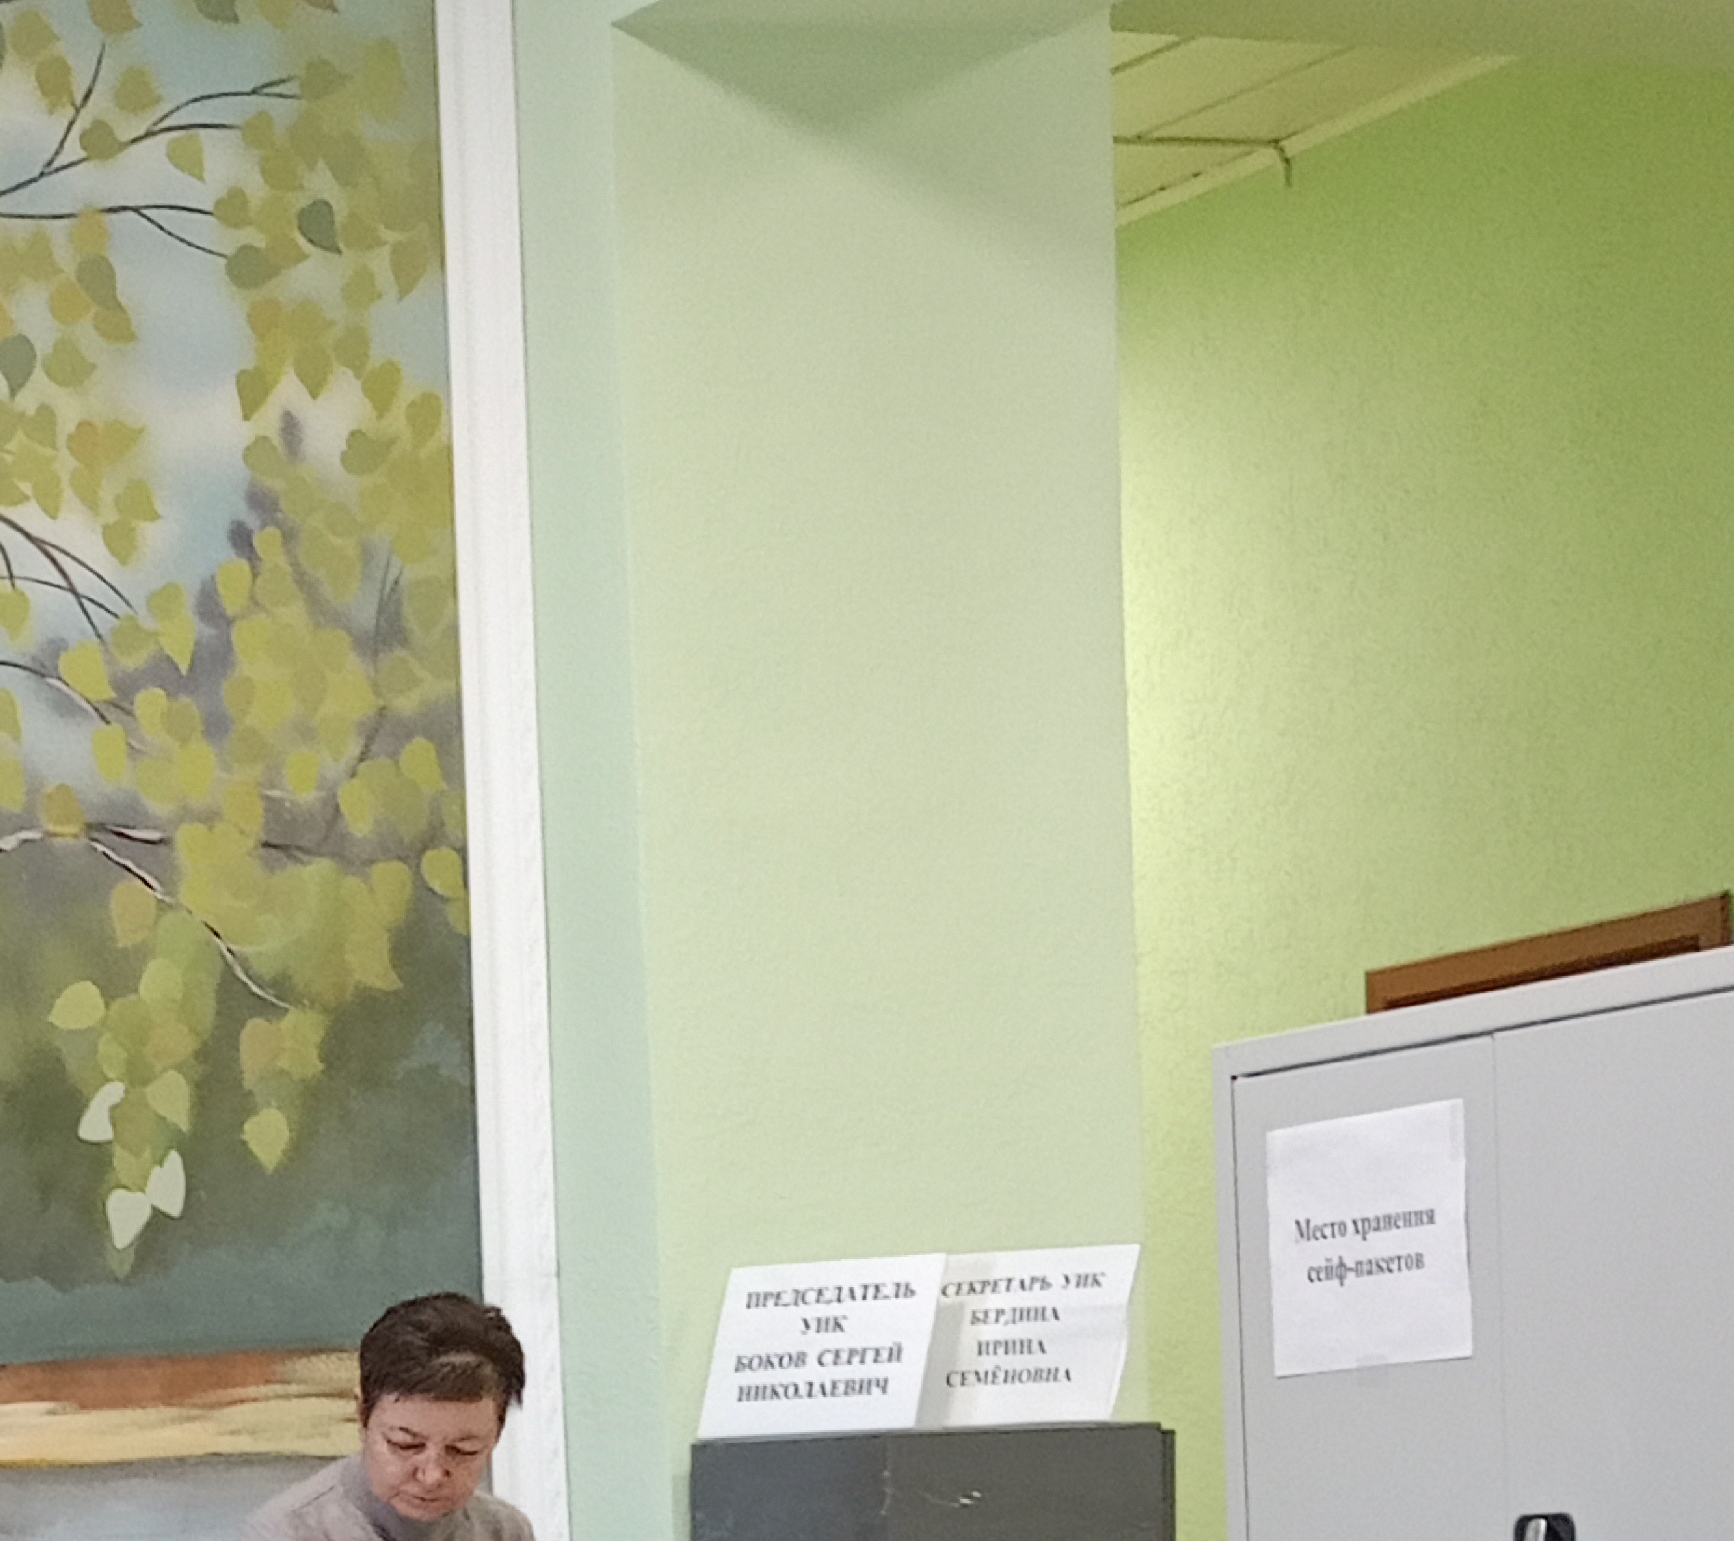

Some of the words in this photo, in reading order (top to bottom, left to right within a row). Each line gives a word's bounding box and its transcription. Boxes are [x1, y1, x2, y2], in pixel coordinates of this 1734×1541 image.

[1295, 1219, 1347, 1243] Место
[1352, 1208, 1436, 1241] хранения
[1307, 1251, 1425, 1287] сейф-пакетов
[746, 1282, 916, 1309] ПРЕДСЕДАТЕЛЬ
[941, 1276, 1053, 1298] СЕКРЕТАРЬ
[1062, 1272, 1106, 1290] УИК
[801, 1315, 848, 1335] УИК
[817, 1341, 903, 1367] СЕРГЕЙ
[977, 1338, 1047, 1356] ИРИНА
[737, 1376, 889, 1402] НИКОЛАЕВИЧ
